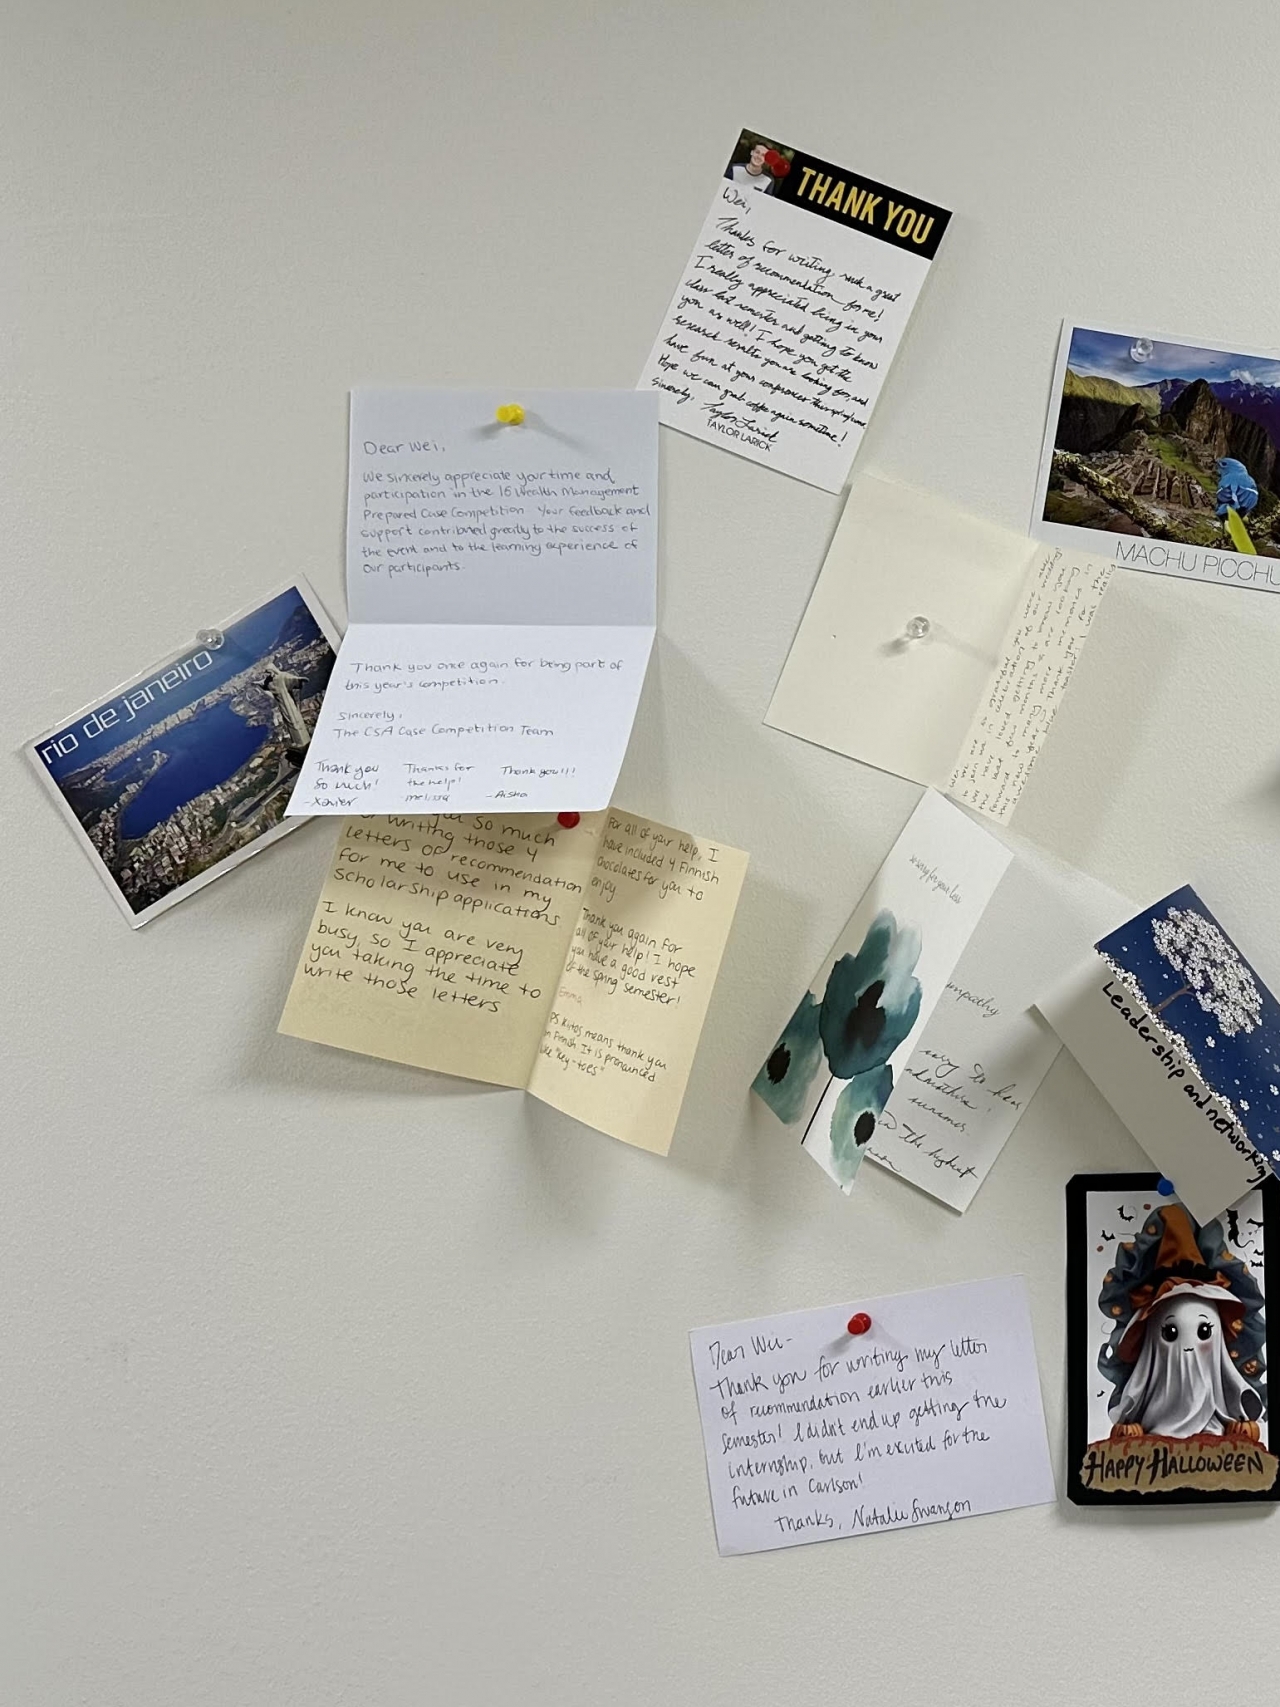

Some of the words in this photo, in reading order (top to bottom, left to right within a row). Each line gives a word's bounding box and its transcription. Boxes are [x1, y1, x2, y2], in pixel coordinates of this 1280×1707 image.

[796, 165, 884, 226] THANK
[882, 199, 936, 245] YOU
[761, 239, 788, 257] for
[362, 440, 405, 456] Dear
[706, 417, 741, 440] TAYLOR
[739, 432, 773, 453] LARICK
[362, 470, 384, 484] We
[443, 470, 512, 488] appreciate
[547, 468, 581, 481] time
[1114, 540, 1199, 573] MACHU
[349, 662, 403, 674] Thank
[407, 663, 433, 674] you
[469, 660, 509, 675] again
[41, 733, 79, 766] rio
[83, 707, 120, 739] de
[122, 650, 213, 723] janeiro
[332, 728, 360, 740] The
[363, 725, 394, 738] CSA
[430, 722, 515, 738] Competition
[520, 724, 555, 737] Team
[387, 813, 456, 850] writing
[462, 832, 516, 856] those
[471, 815, 494, 832] so
[501, 824, 556, 848] much
[345, 825, 413, 853] letters
[450, 854, 583, 895] recommendation
[379, 857, 407, 874] me
[414, 861, 435, 878] to
[446, 870, 481, 889] use
[493, 882, 512, 894] in
[522, 889, 553, 913] my
[686, 886, 704, 902] to
[321, 900, 338, 914] I
[344, 902, 394, 926] know
[398, 921, 432, 941] you
[443, 929, 476, 947] are
[486, 938, 524, 966] very
[627, 927, 658, 949] again
[308, 942, 342, 964] you
[351, 947, 416, 984] taking
[424, 964, 457, 985] the
[464, 971, 510, 996] time
[518, 982, 542, 1000] to
[369, 932, 392, 949] so
[402, 936, 419, 953] I
[424, 946, 521, 977] appreciate
[666, 956, 697, 980] hope
[303, 962, 354, 983] write
[362, 972, 419, 999] those
[431, 987, 502, 1014] letters
[1102, 981, 1186, 1079] Leadership
[1183, 1083, 1206, 1110] and
[1205, 1108, 1268, 1184] networking
[708, 1340, 746, 1371] Dear
[708, 1371, 770, 1400] Thank
[771, 1369, 808, 1395] you
[813, 1354, 841, 1383] for
[845, 1346, 910, 1374] writing
[913, 1343, 947, 1371] my
[720, 1401, 738, 1427] of
[749, 1390, 861, 1419] recommendation
[866, 1376, 917, 1400] earlier
[920, 1370, 954, 1390] this
[850, 1409, 880, 1433] end
[880, 1410, 901, 1430] up
[908, 1397, 971, 1428] getting
[972, 1388, 1008, 1410] the
[941, 1430, 961, 1451] for
[961, 1425, 991, 1445] the
[1083, 1450, 1145, 1487] HAPPY
[1145, 1448, 1265, 1486] HALLOWEEN
[731, 1484, 781, 1510] future
[782, 1484, 799, 1500] in
[851, 1503, 910, 1530] Natalie
